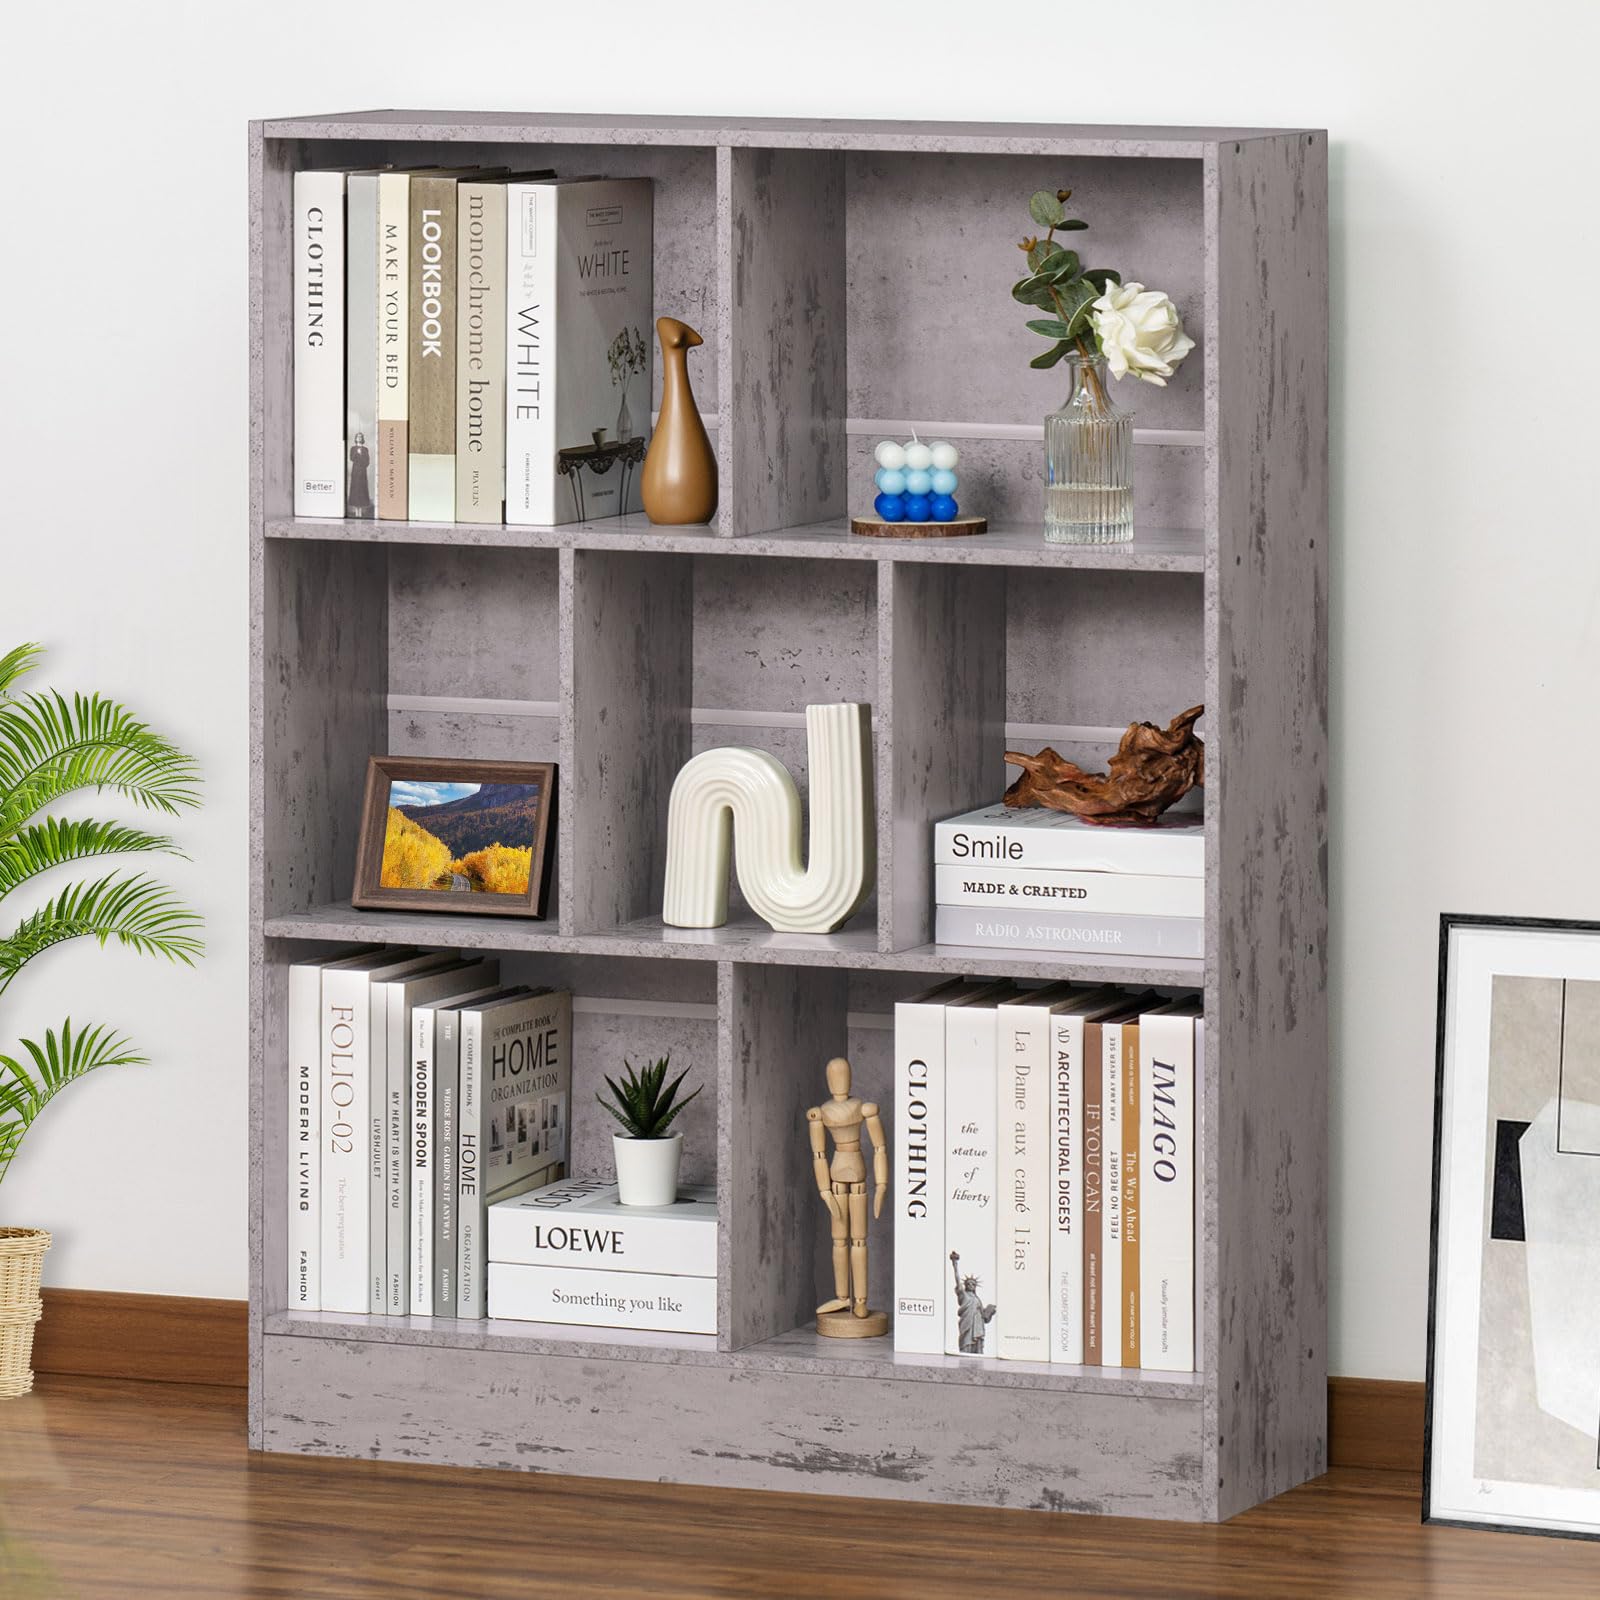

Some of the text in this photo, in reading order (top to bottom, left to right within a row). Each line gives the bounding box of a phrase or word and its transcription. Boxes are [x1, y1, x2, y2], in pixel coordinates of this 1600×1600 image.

[307, 207, 323, 348] CLOTHING
[578, 250, 629, 278] WHITE
[422, 209, 441, 358] LOOKBOOK
[385, 224, 398, 389] MAKE YOUR BED
[467, 195, 489, 453] monochrome home
[516, 305, 539, 420] WHITE
[306, 482, 332, 490] Better
[952, 833, 1024, 860] Smile
[963, 882, 1087, 899] MADE & CRAFTED
[976, 923, 1122, 943] RADIO ASTRONOMER
[501, 1019, 534, 1036] COMPLETE
[534, 1015, 551, 1030] BOOK
[492, 1030, 558, 1081] HOME
[331, 1006, 354, 1154] FOLIO-02
[491, 1072, 558, 1103] ORGANIZATION
[392, 1091, 399, 1106] MY
[416, 1060, 427, 1168] WOODEN SPOON
[961, 1122, 979, 1134] the
[1057, 1026, 1070, 1235] AD ARCHITECTURAL DIGEST
[1152, 1058, 1177, 1183] IMAGO
[299, 1066, 309, 1211] MODERN LIVING
[392, 1146, 399, 1155] IS
[907, 1059, 928, 1219] CLOTHING
[952, 1145, 988, 1157] statue
[1014, 1030, 1031, 1271] La Dame aux camé lias
[443, 1146, 451, 1181] GARDEN
[461, 1134, 476, 1195] HOME
[1085, 1103, 1100, 1213] IF YOU CAN
[443, 1183, 451, 1191] IS
[963, 1167, 979, 1183] of
[443, 1193, 451, 1202] IT
[520, 1180, 617, 1208] LOEWE
[952, 1190, 990, 1208] liberty
[1109, 1151, 1119, 1239] FEEL NO REGRET
[1125, 1151, 1137, 1242] The Way Ahead
[535, 1226, 625, 1254] LOEWE
[300, 1251, 308, 1301] FASHION
[463, 1225, 471, 1302] ORGANIZATION
[552, 1289, 682, 1313] Something you like
[900, 1301, 932, 1312] Better
[1061, 1289, 1069, 1326] COMFORT
[1160, 1279, 1169, 1305] Visually
[1161, 1307, 1169, 1329] similar
[1061, 1328, 1069, 1352] ZOOM
